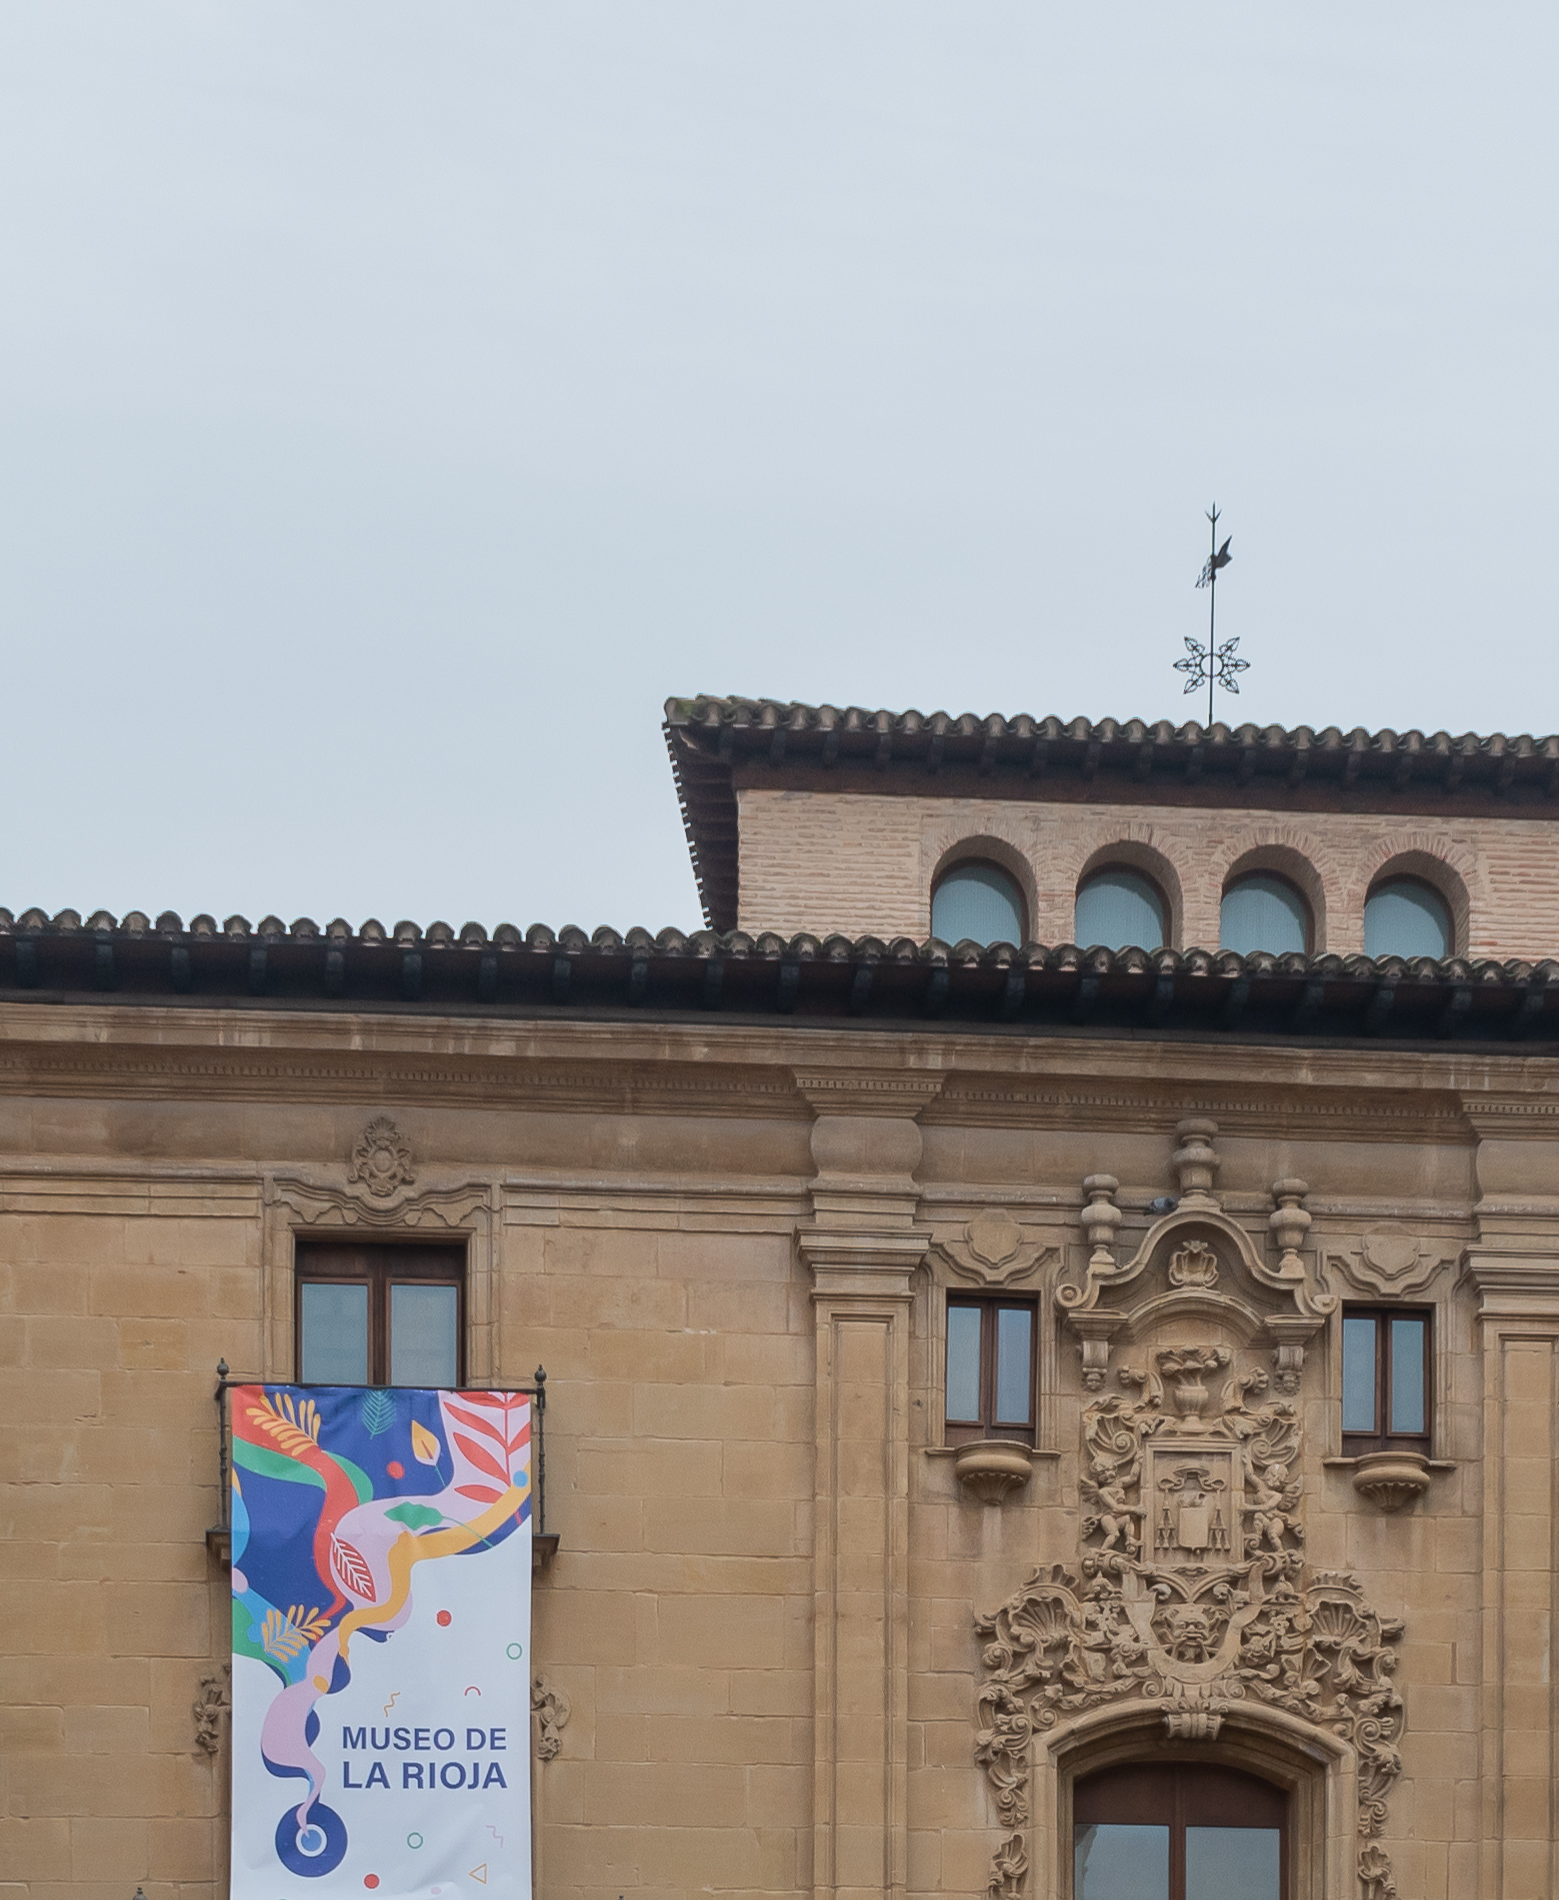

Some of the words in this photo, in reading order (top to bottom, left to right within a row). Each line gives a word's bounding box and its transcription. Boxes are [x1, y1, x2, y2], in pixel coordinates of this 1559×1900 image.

[342, 1726, 455, 1751] MUSEO
[466, 1728, 507, 1751] DE
[343, 1761, 391, 1789] LA
[402, 1762, 508, 1790] RIOJA
